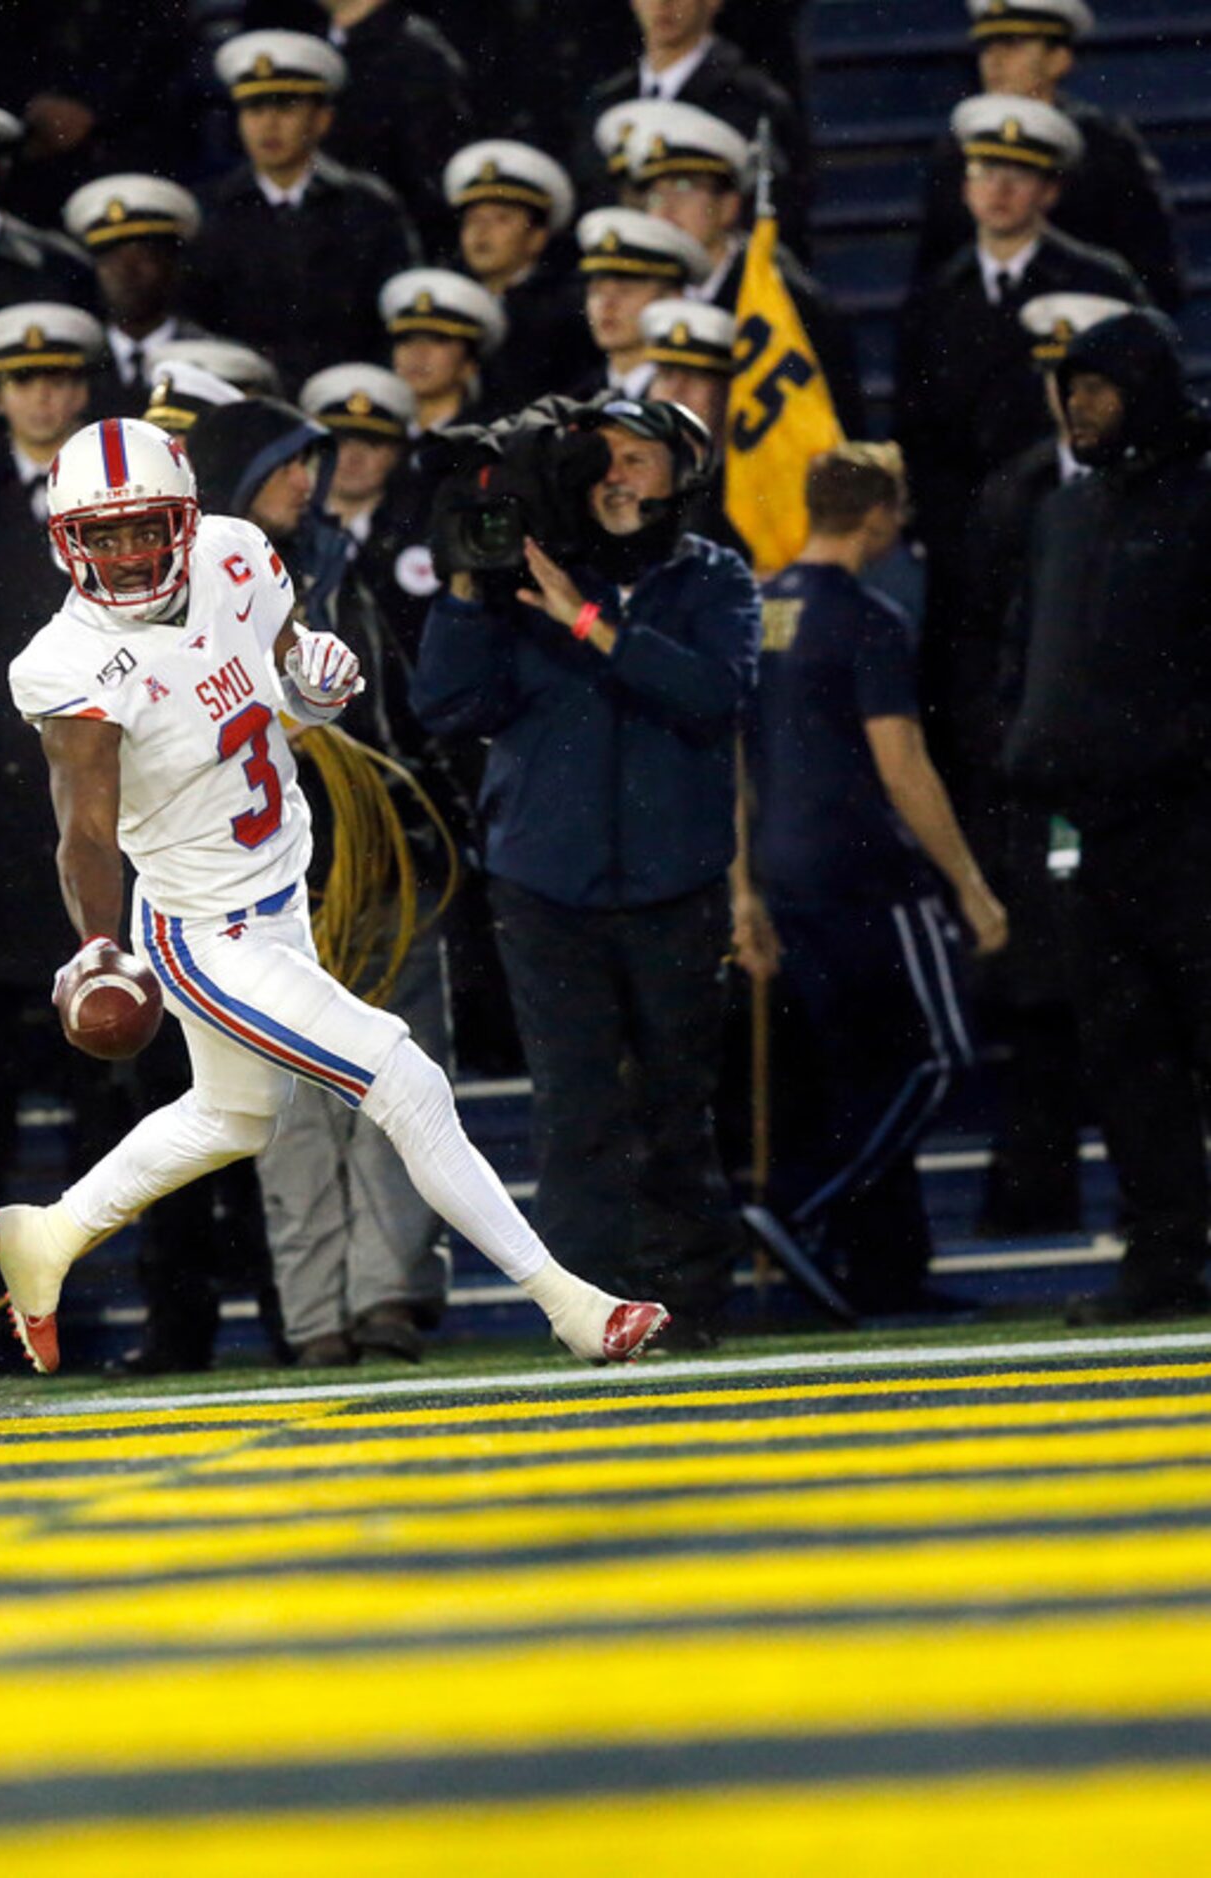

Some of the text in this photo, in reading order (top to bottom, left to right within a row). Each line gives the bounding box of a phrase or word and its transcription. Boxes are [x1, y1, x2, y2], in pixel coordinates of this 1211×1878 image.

[222, 552, 253, 586] C
[96, 647, 138, 686] 150
[195, 656, 255, 721] SMU
[216, 700, 282, 850] 3
